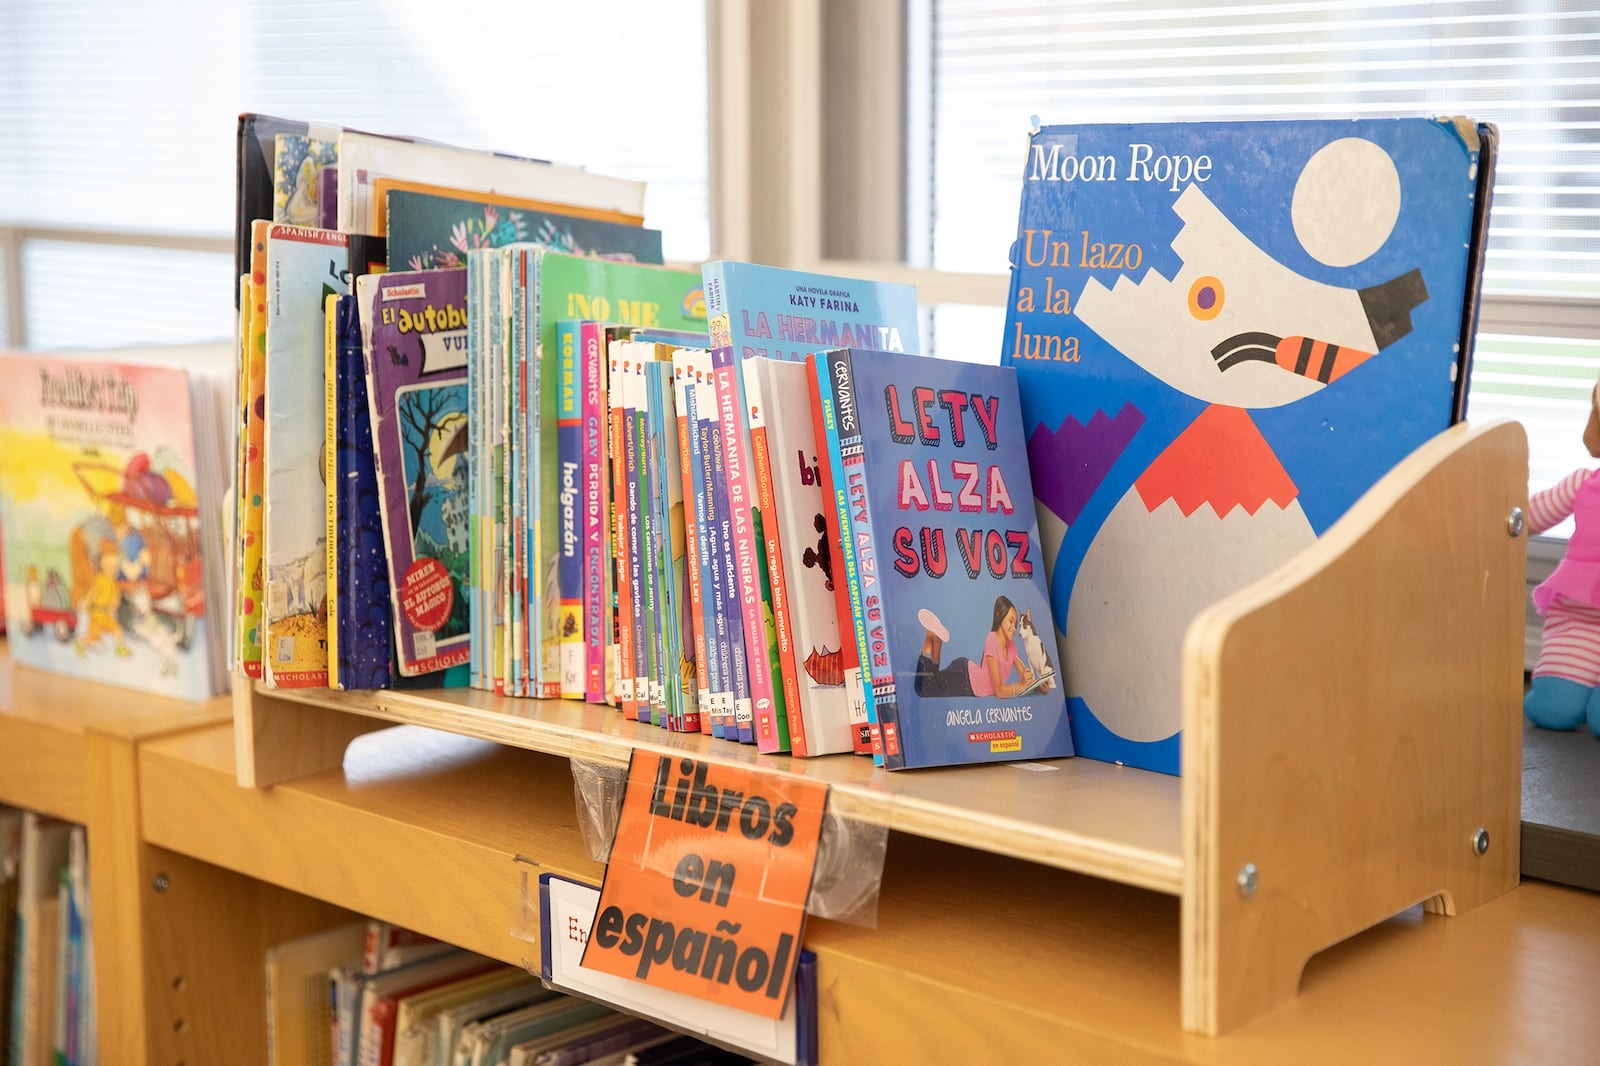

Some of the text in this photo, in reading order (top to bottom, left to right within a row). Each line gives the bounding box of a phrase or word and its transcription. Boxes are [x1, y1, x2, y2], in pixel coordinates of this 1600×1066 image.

[1029, 144, 1213, 192] Moon Rope
[281, 227, 318, 239] SPANISH
[1024, 229, 1143, 270] Un lazo
[567, 292, 660, 328] ¡NO ME
[789, 294, 860, 313] KATY FARINA
[808, 287, 828, 296] NOVELA
[1016, 277, 1071, 315] a la
[382, 307, 395, 325] El
[741, 310, 904, 353] LA HERMANITA
[719, 352, 725, 362] 1
[1012, 322, 1081, 363] luna
[562, 333, 573, 412] KORMAN
[824, 399, 834, 430] PILKEY
[884, 384, 999, 450] LETY
[629, 482, 638, 511] Dando
[718, 372, 755, 604] LA HERMANITA DE LAS NIÑERAS
[897, 459, 1014, 516] ALZA
[560, 462, 578, 557] holgazán
[631, 513, 637, 525] de
[697, 492, 709, 566] Vamos al desfile
[588, 416, 600, 648] GABY PERDIDA Y ENCONTRADA
[617, 513, 625, 548] Trabajar
[689, 524, 700, 603] La mariquita Lara
[711, 559, 720, 581] agua
[722, 520, 736, 598] Uno es suficiente
[849, 473, 887, 667] LETY ALZA SU VOZ
[893, 526, 1033, 579] SU VOZ
[406, 562, 435, 586] MIREN
[837, 489, 871, 683] LAS AVENTURAS DEL CAPITÁN CALZONCILLOS
[404, 597, 415, 611] EL
[632, 579, 641, 618] gaviotas
[715, 592, 725, 611] más
[749, 609, 755, 619] LA
[768, 540, 788, 652] Un regalo bien envuelto
[715, 612, 725, 635] agua
[750, 620, 758, 644] BRUJA
[786, 678, 799, 734] Children's Press
[975, 731, 1016, 740] SCHOLASTIC
[1000, 740, 1020, 750] español
[648, 755, 798, 847] Libros
[672, 853, 736, 908] en
[568, 916, 588, 944] En
[596, 905, 794, 1000] español
